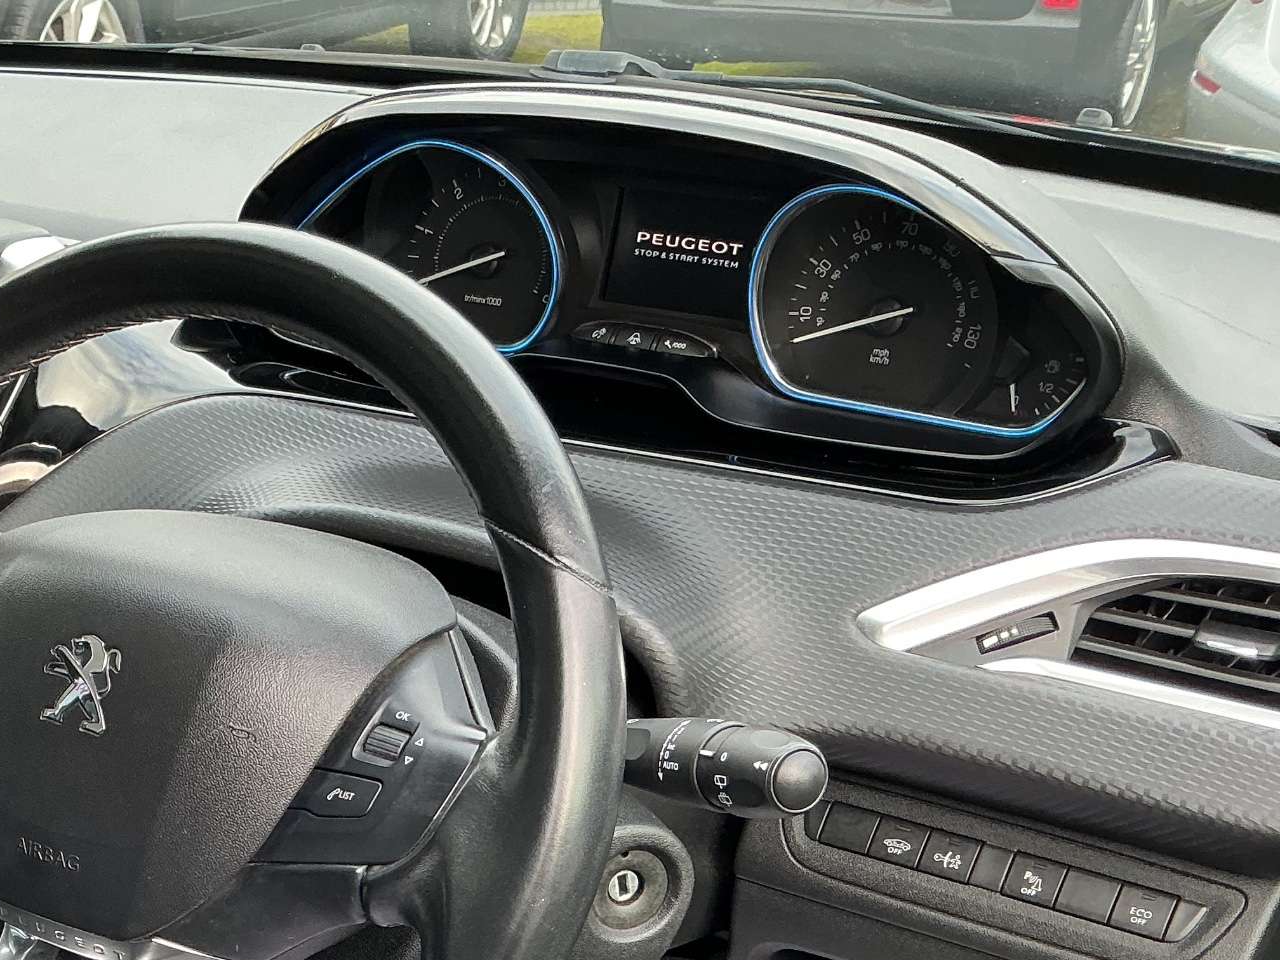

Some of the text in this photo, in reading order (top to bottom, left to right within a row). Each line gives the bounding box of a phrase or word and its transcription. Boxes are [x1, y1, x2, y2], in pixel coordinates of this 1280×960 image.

[452, 187, 464, 200] 2
[901, 221, 919, 236] 70
[852, 228, 871, 245] 50
[636, 231, 744, 256] PEUGEOT
[634, 248, 660, 258] STOP
[668, 252, 700, 263] START
[701, 257, 739, 269] SYSTEM
[814, 259, 831, 278] 30
[800, 306, 812, 322] 10
[963, 324, 981, 349] 130
[872, 347, 890, 358] mph
[869, 355, 890, 366] km/h
[395, 711, 412, 722] OK
[662, 761, 679, 771] AUTO
[338, 790, 356, 801] LIST
[18, 836, 80, 872] AIRBAG
[887, 846, 903, 856] OFF
[1020, 886, 1037, 896] OFF
[1129, 906, 1153, 919] ECO
[1130, 916, 1148, 926] OFF
[0, 906, 126, 960] UGEOT
